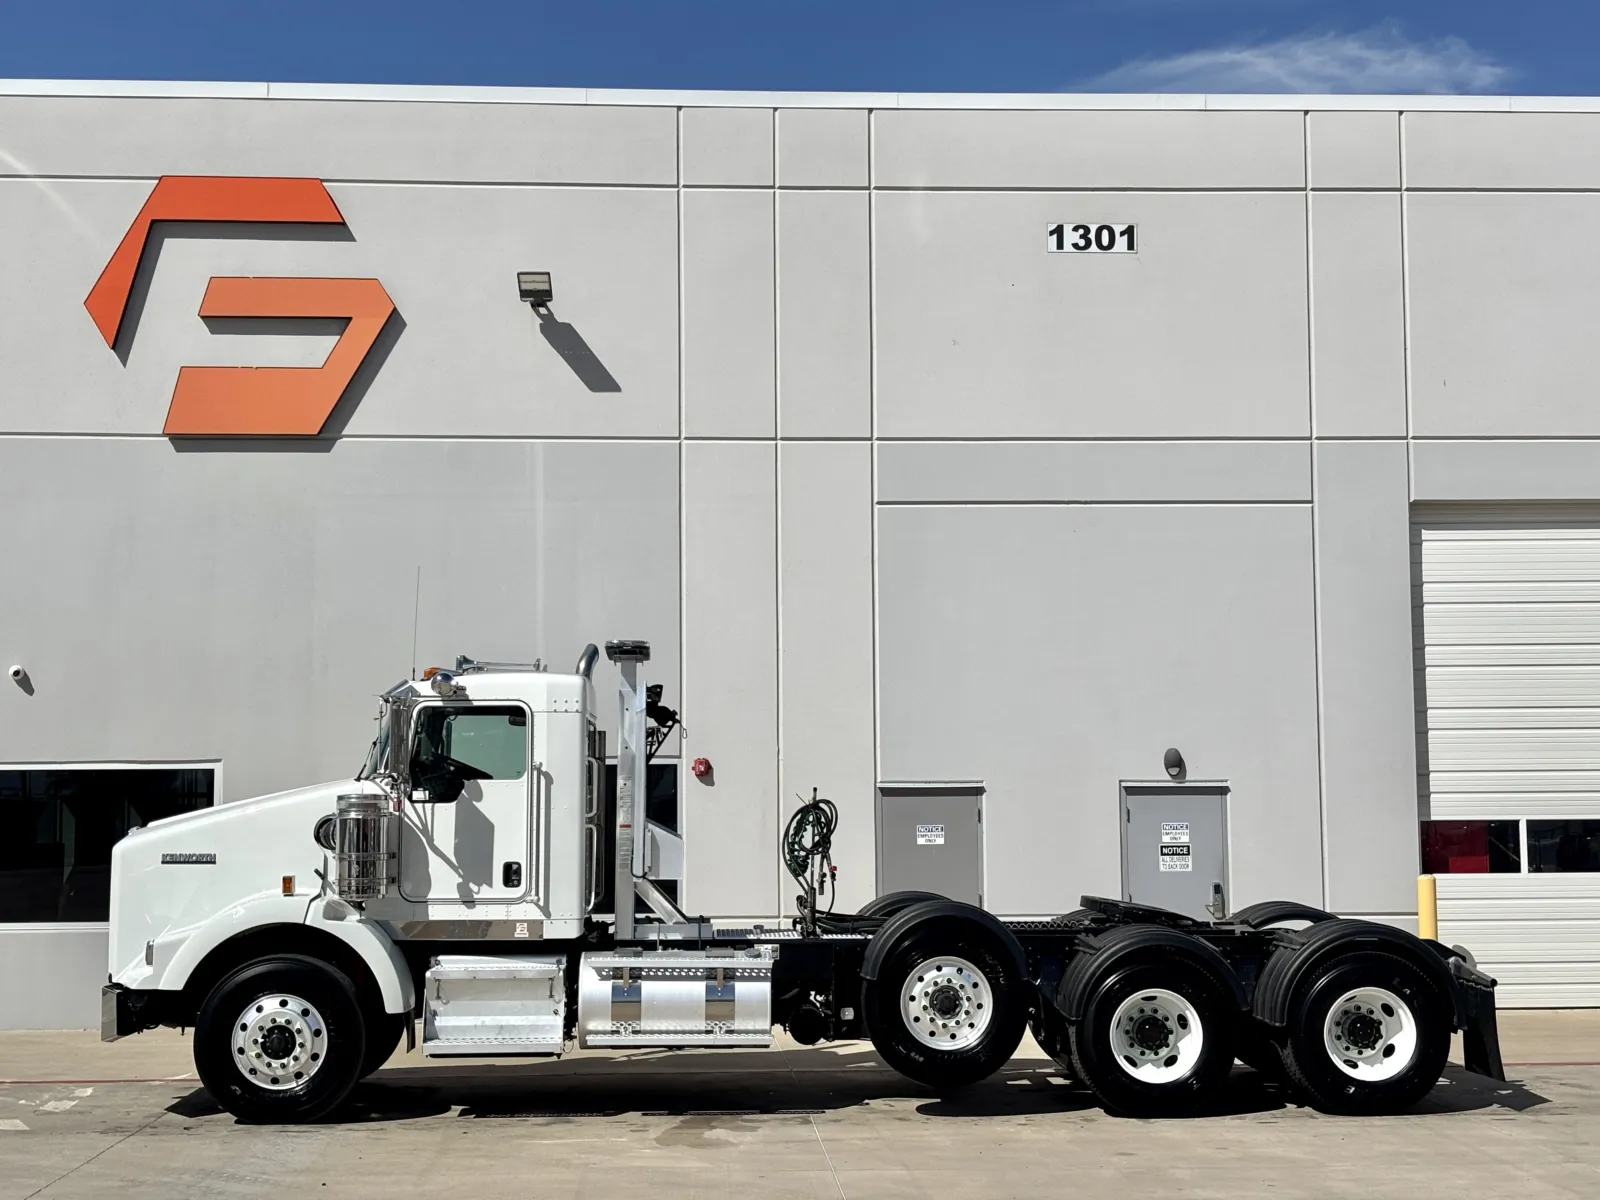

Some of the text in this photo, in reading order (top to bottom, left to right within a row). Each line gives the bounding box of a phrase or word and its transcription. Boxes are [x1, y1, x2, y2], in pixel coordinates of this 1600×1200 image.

[1048, 224, 1135, 252] 1301
[1162, 846, 1189, 854] NOTICE
[161, 853, 217, 862] KENWORTH
